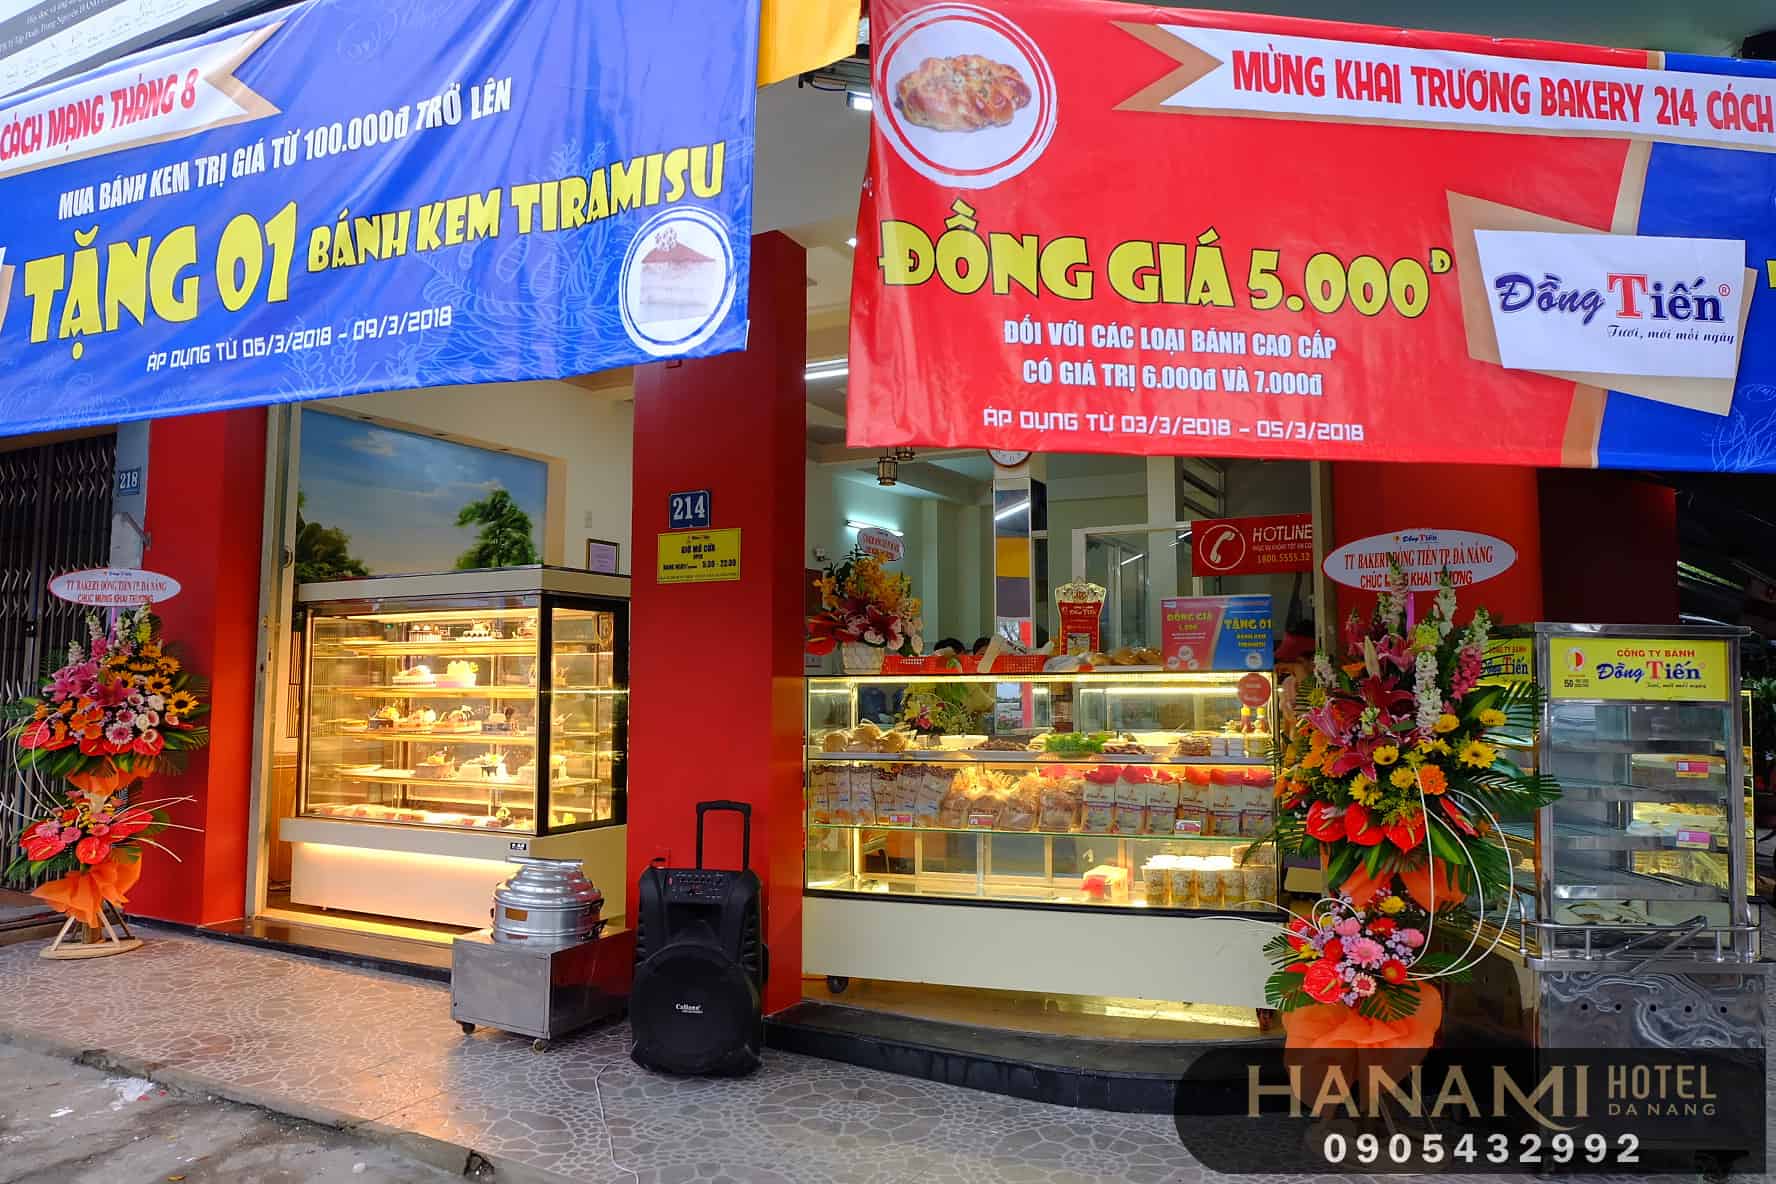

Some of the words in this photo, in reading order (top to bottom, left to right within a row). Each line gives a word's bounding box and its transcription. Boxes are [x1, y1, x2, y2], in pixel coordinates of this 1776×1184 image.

[1232, 43, 1326, 97] MỪNG
[1335, 59, 1402, 104] KHAI
[1539, 77, 1644, 122] BAKERY
[1654, 86, 1697, 127] 214
[1707, 82, 1775, 133] CÁCH
[0, 112, 42, 160] CÁCH
[47, 95, 104, 151] MẠNG
[111, 73, 177, 128] THÁNG
[181, 68, 197, 109] 8
[58, 189, 94, 220] MUA
[99, 173, 147, 210] BÁNH
[150, 162, 190, 197] KEM
[195, 153, 226, 188] TRỊ
[231, 137, 264, 178] GIÁ
[272, 127, 302, 168] TỪ
[304, 105, 410, 160] 100.000đ
[470, 75, 512, 120] LÊN
[24, 224, 200, 360] TẶNG
[216, 200, 297, 312] 01
[307, 206, 412, 272] BÁNH
[415, 187, 503, 252] KEM
[510, 141, 726, 235] TIRAMISU
[877, 198, 1095, 300] ĐỒNG
[1107, 226, 1235, 308] GIÁ
[1495, 272, 1605, 325] Đồng
[1607, 272, 1726, 322] Tiến
[146, 350, 167, 373] ÁP
[170, 343, 211, 371] DỤNG
[216, 337, 238, 361] TỪ
[242, 326, 332, 358] 06/3/2018
[352, 305, 452, 341] 09/3/2018
[1003, 313, 1042, 345] ĐỐI
[1048, 319, 1085, 347] VỚI
[1091, 321, 1135, 349] CÁC
[1140, 326, 1185, 356] LOẠI
[1191, 327, 1248, 354] BÁNH
[1252, 332, 1292, 357] CAO
[1298, 328, 1337, 359] CẤP
[1023, 356, 1053, 384] CÓ
[1059, 359, 1097, 386] GIÁ
[1101, 363, 1136, 392] TRỊ
[1142, 365, 1217, 391] 6.000đ
[1221, 366, 1250, 393] VÀ
[1254, 370, 1323, 396] 7.000đ
[982, 405, 1013, 428] ÁP
[1019, 411, 1079, 433] DỤNG
[1085, 410, 1115, 432] TỪ
[1121, 415, 1231, 436] 03/3/2018
[1256, 419, 1364, 441] 05/3/2018
[120, 472, 138, 489] 218
[673, 495, 705, 520] 214
[1252, 523, 1312, 543] HOTLINE
[1410, 571, 1432, 586] KHAI
[1596, 662, 1645, 683] Đồng
[1646, 660, 1701, 680] Tiến
[1648, 648, 1661, 657] TY
